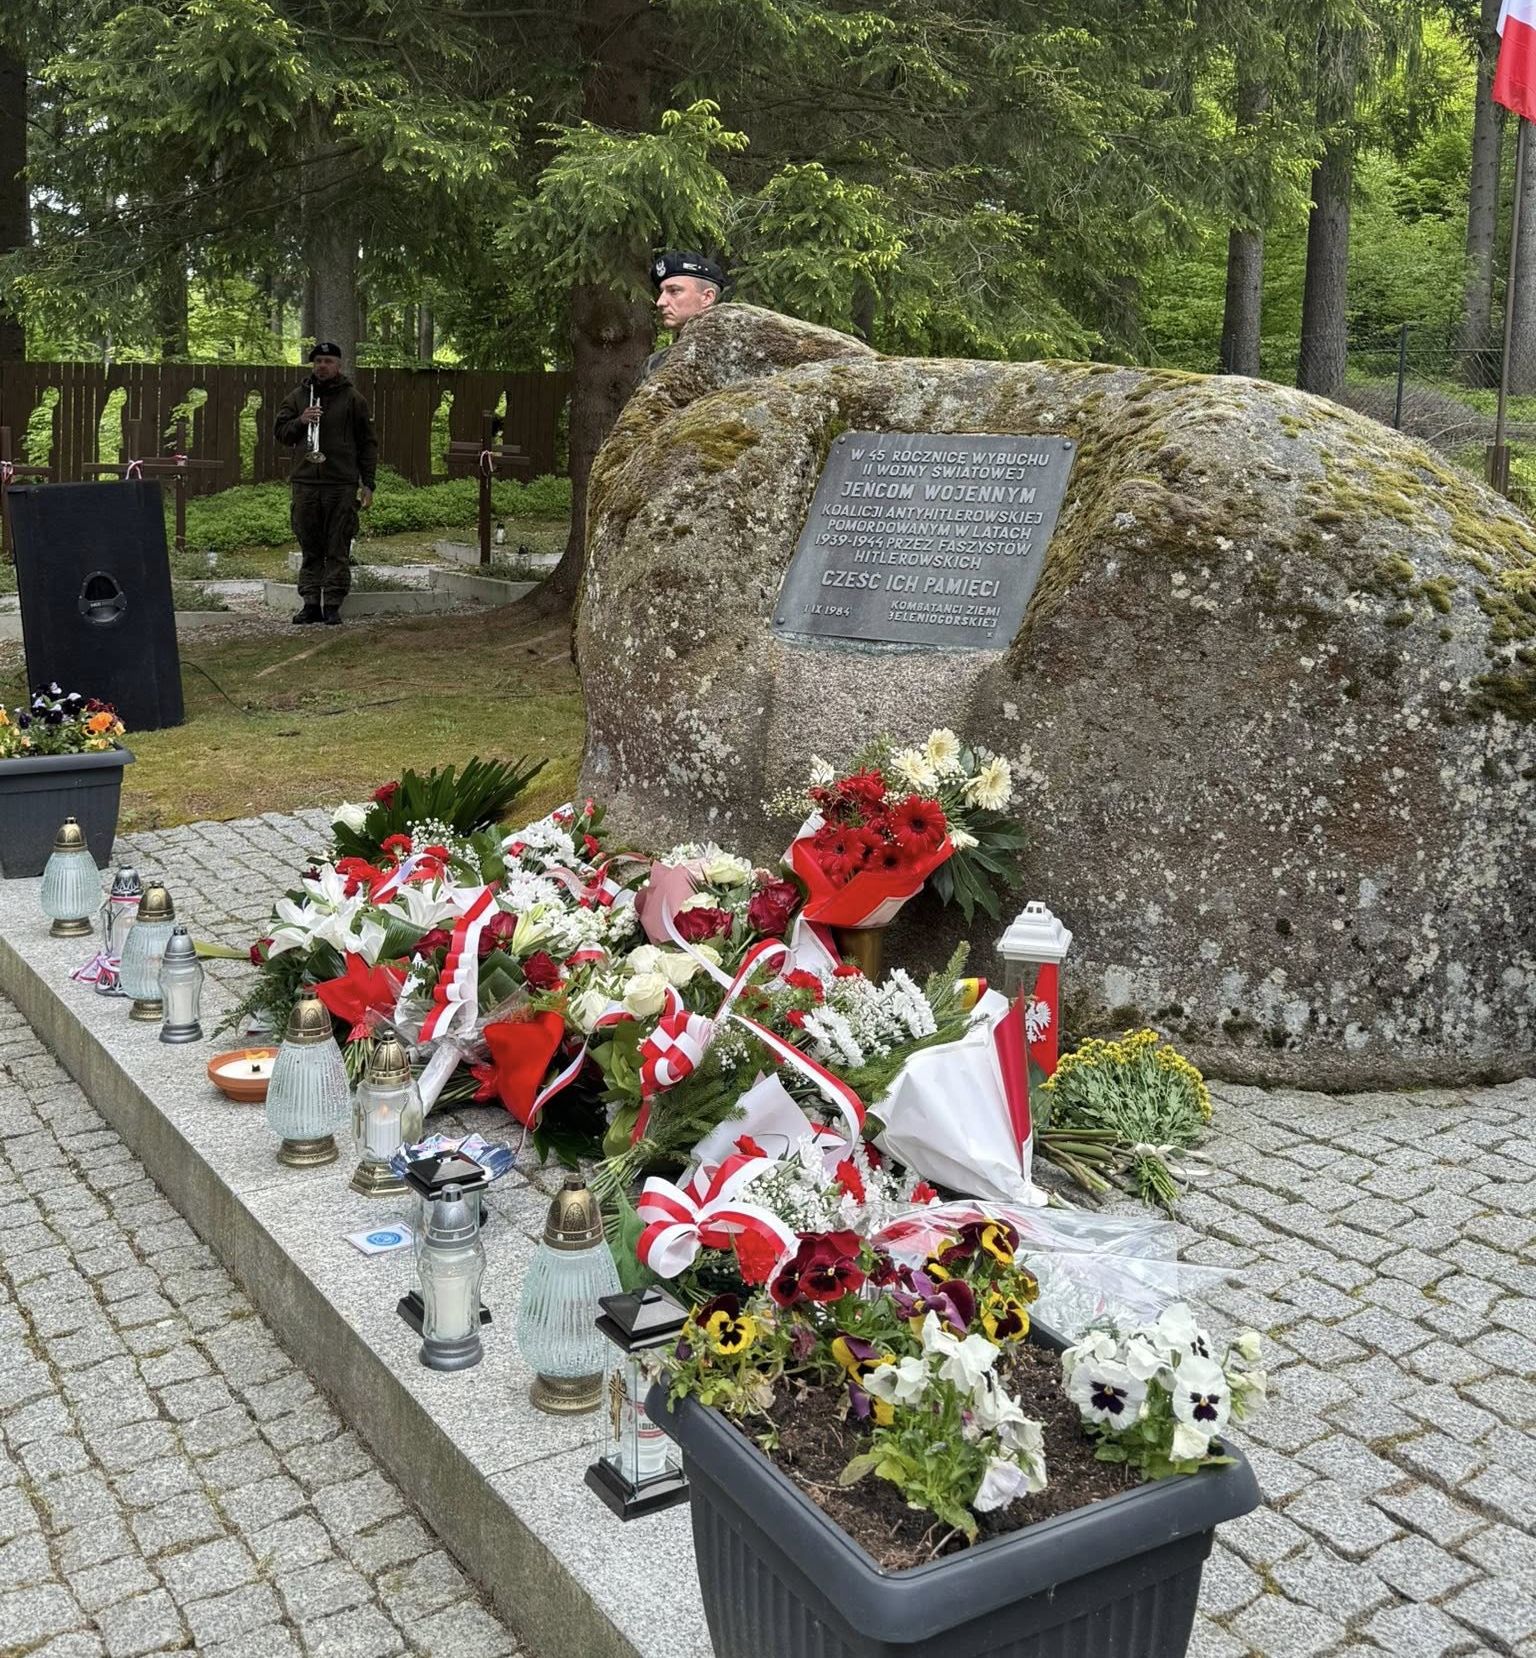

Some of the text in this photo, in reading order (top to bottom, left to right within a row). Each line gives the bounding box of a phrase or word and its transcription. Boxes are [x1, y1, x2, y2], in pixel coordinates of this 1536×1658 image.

[851, 448, 1050, 466] W 45 ROCZNICĘ WYBUCHU
[862, 463, 1026, 480] II WOJNY ŚWIATOWEJ
[840, 480, 1037, 504] JEŃCOM WOJENNYM
[821, 503, 1043, 525] KOALICJI ANTYHITLEROWSKIEJ
[827, 519, 1032, 540] POMORDOWANYM W LATACH
[815, 533, 1033, 556] 1939-1944 PRZEZ FASZYSTÓW
[853, 549, 982, 570] HITLEROWSKICH
[821, 570, 1000, 599] CZEŚĆ ICH PAMIĘCI
[811, 604, 822, 615] IX
[891, 600, 1001, 617] KOMBATANCI ZIEMI
